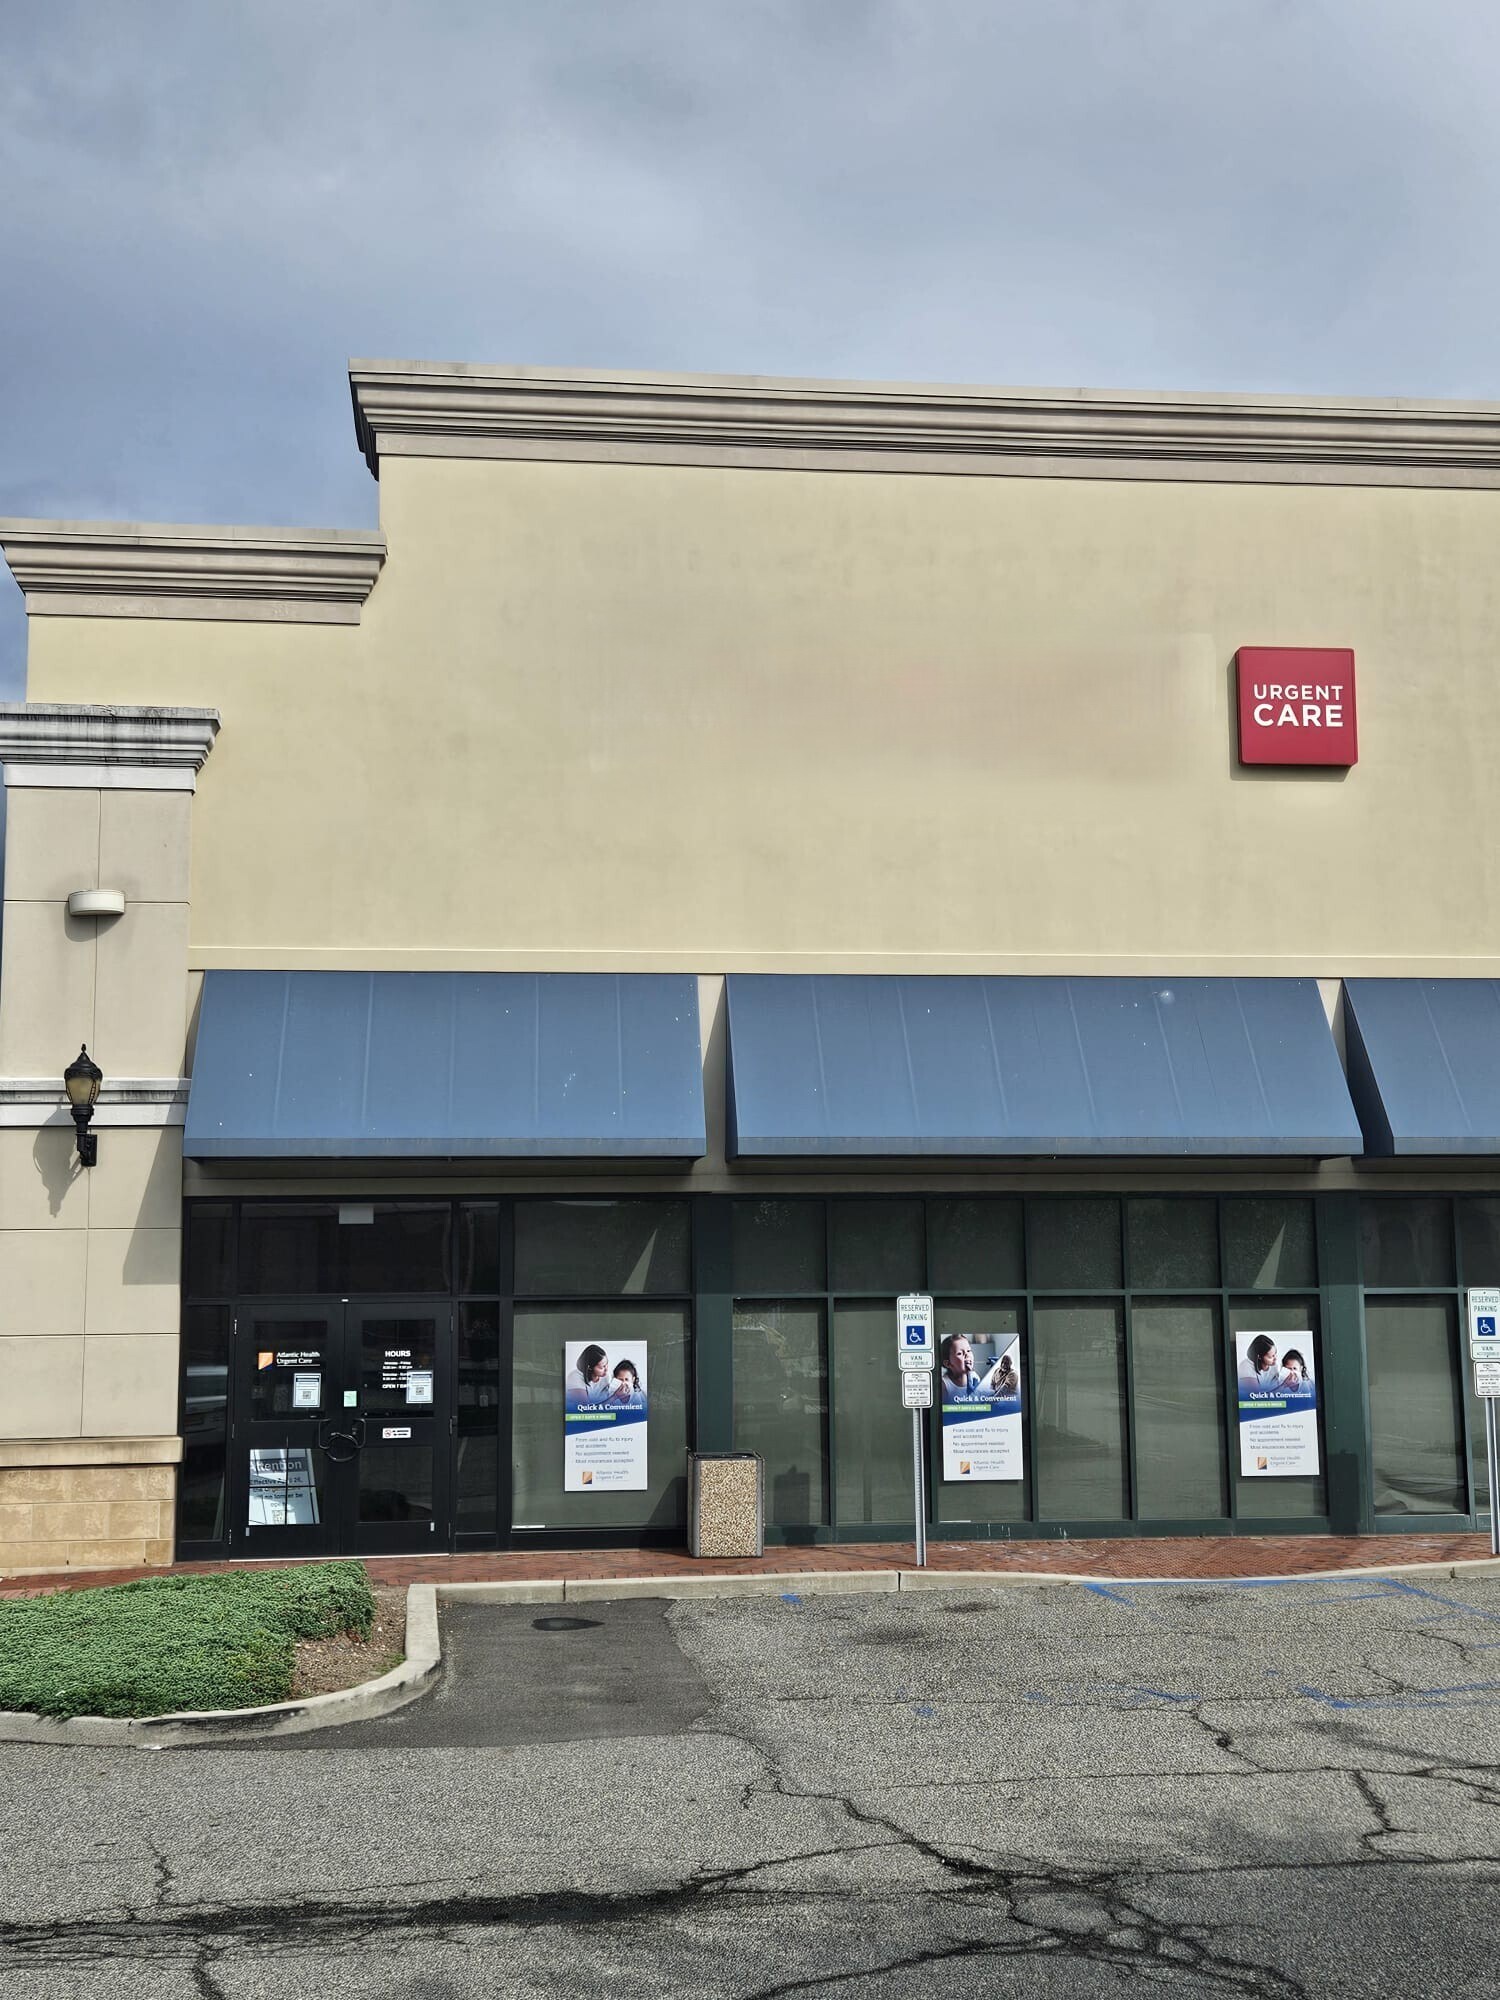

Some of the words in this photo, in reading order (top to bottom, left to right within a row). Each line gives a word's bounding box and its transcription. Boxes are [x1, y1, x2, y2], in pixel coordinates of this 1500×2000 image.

[1254, 684, 1344, 700] URGENT
[1254, 704, 1344, 727] CARE
[250, 1460, 302, 1471] Attenton
